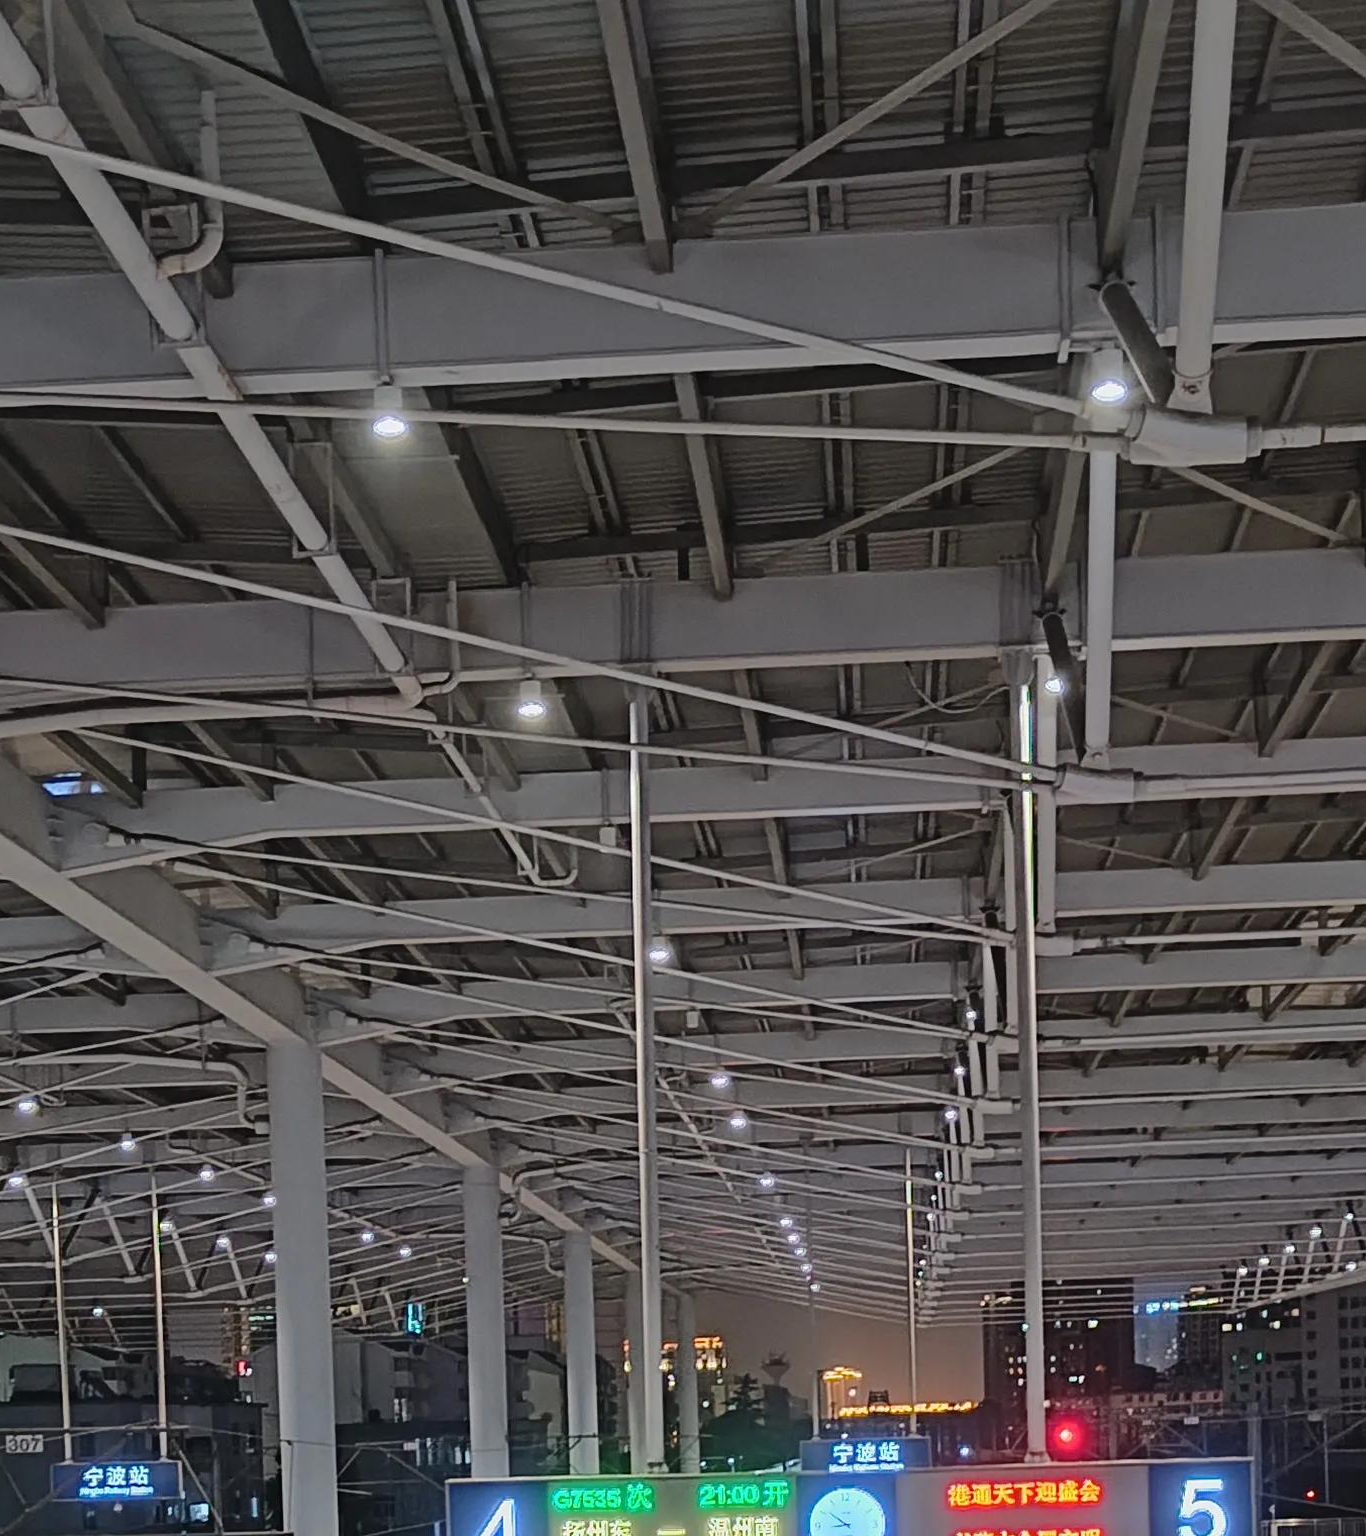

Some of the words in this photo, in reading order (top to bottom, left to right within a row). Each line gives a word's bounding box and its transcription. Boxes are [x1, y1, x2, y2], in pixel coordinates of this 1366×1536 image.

[832, 1441, 900, 1464] 宁波站
[82, 1465, 149, 1487] 宁波站
[627, 1482, 653, 1511] 次
[698, 1484, 760, 1506] 21:00
[762, 1480, 789, 1507] 开
[947, 1479, 1102, 1507] 港通天下迎盛会
